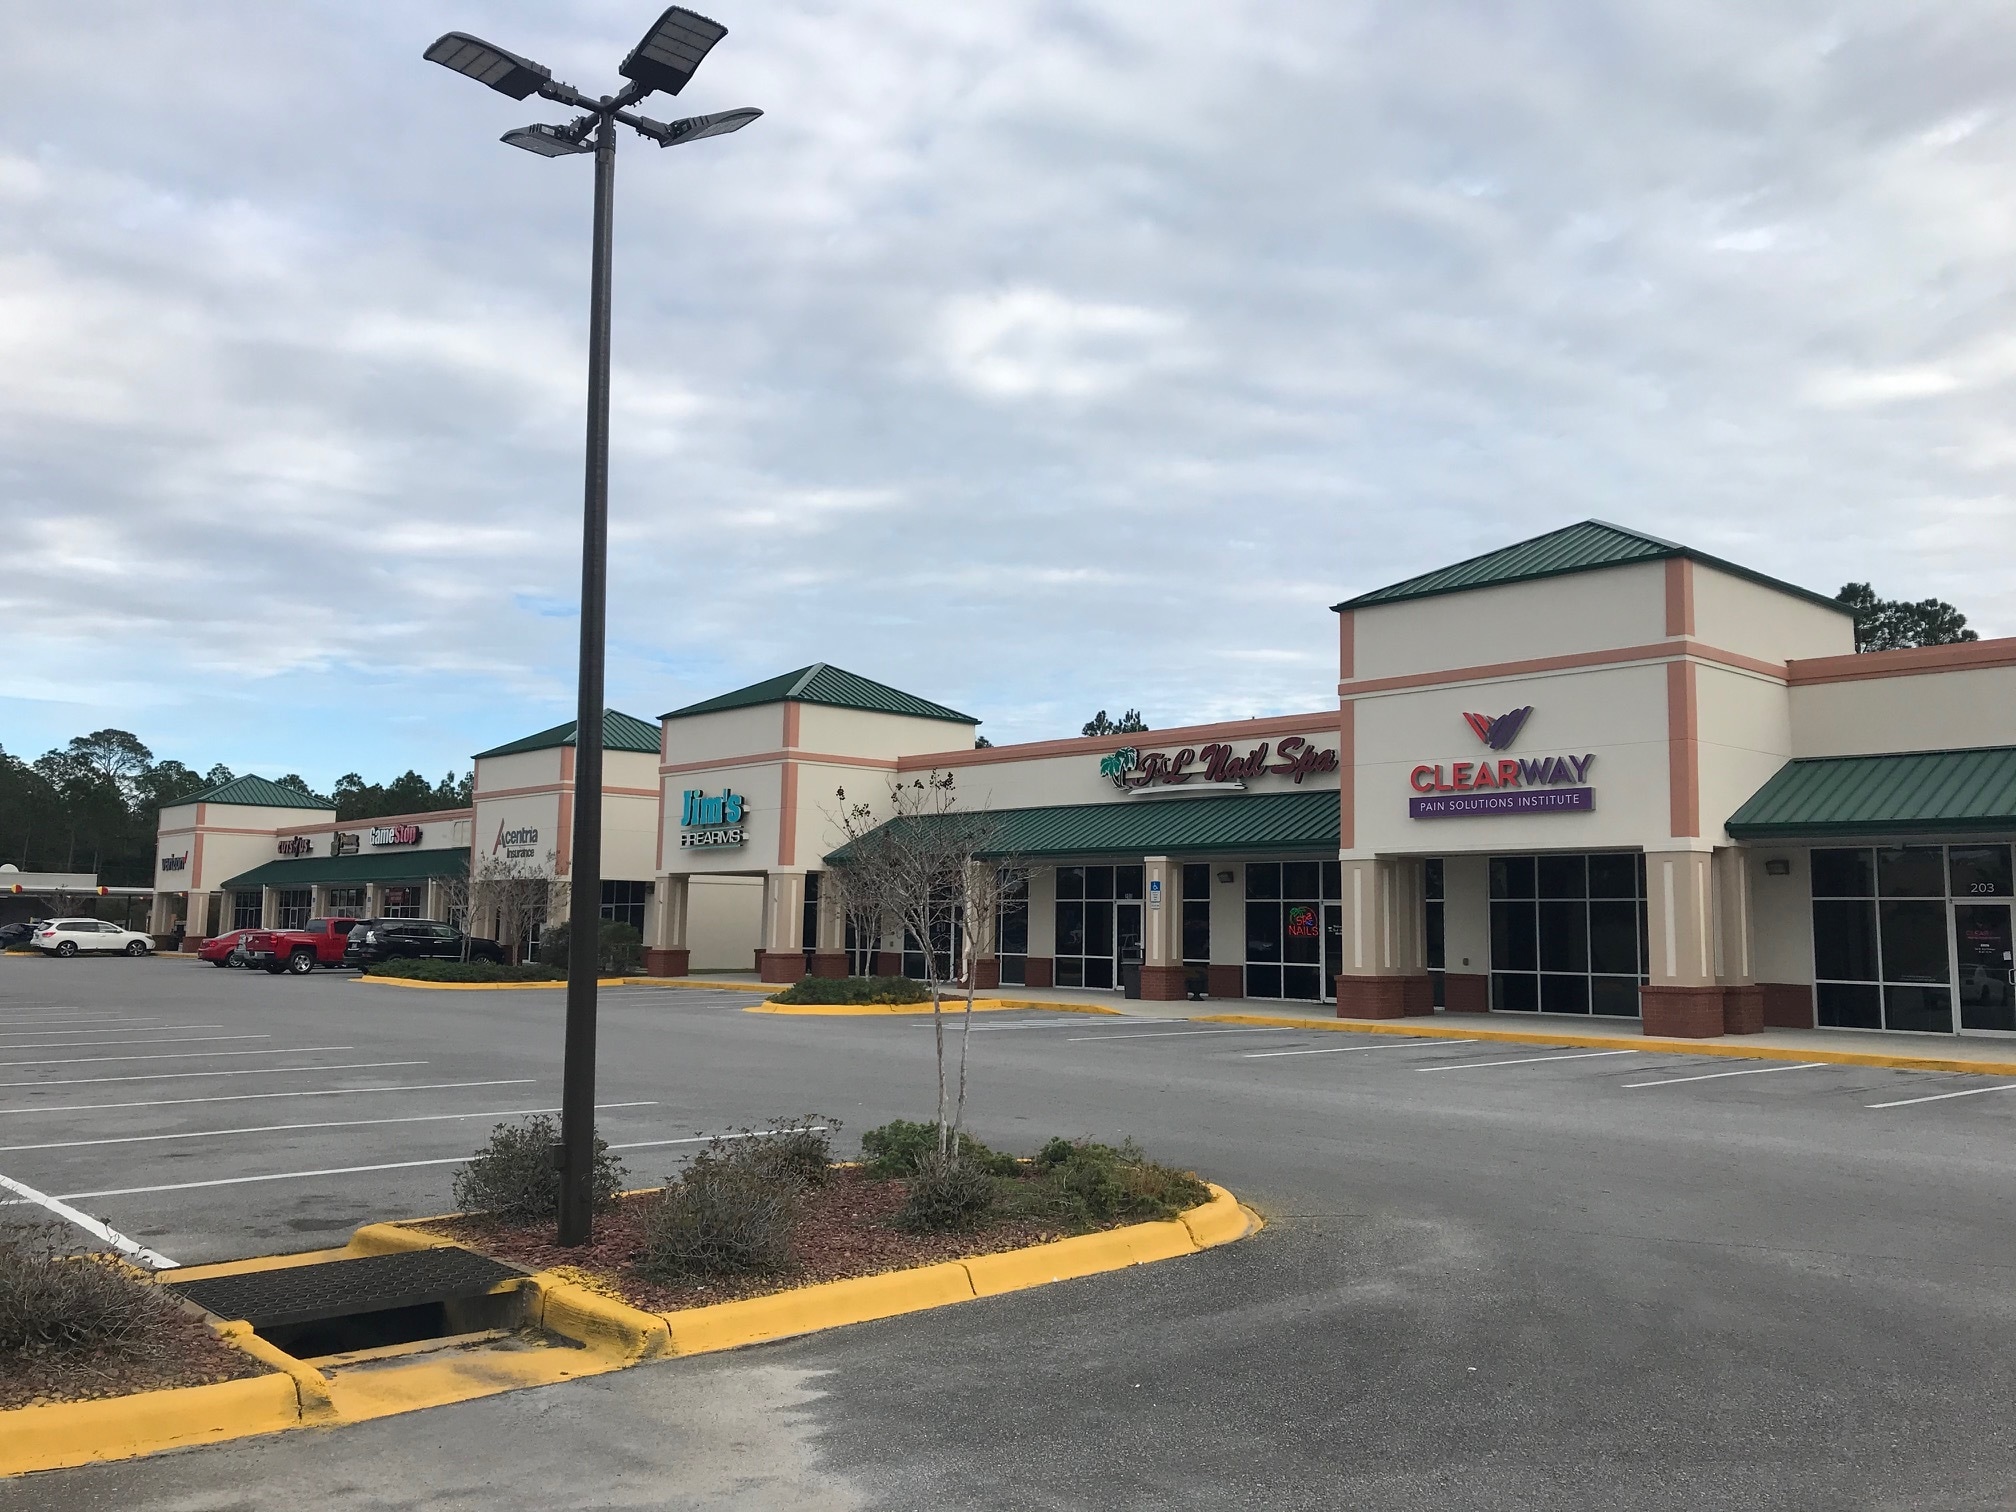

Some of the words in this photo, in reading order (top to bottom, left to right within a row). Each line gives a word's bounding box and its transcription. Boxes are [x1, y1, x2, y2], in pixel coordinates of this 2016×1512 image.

[1199, 742, 1269, 783] Nail
[1270, 736, 1339, 785] Spa
[1410, 753, 1596, 794] CLEARWAY
[681, 788, 744, 827] Jim's
[1419, 800, 1446, 812] PAIN
[1449, 796, 1514, 811] SOLUTIONS
[1518, 793, 1581, 807] INSTITUTE
[369, 824, 420, 847] GameStop
[492, 817, 539, 856] Acentria
[681, 829, 743, 847] FIREARMS
[506, 847, 535, 859] Insurance
[1970, 882, 1996, 893] 203
[1288, 925, 1319, 936] NAILS
